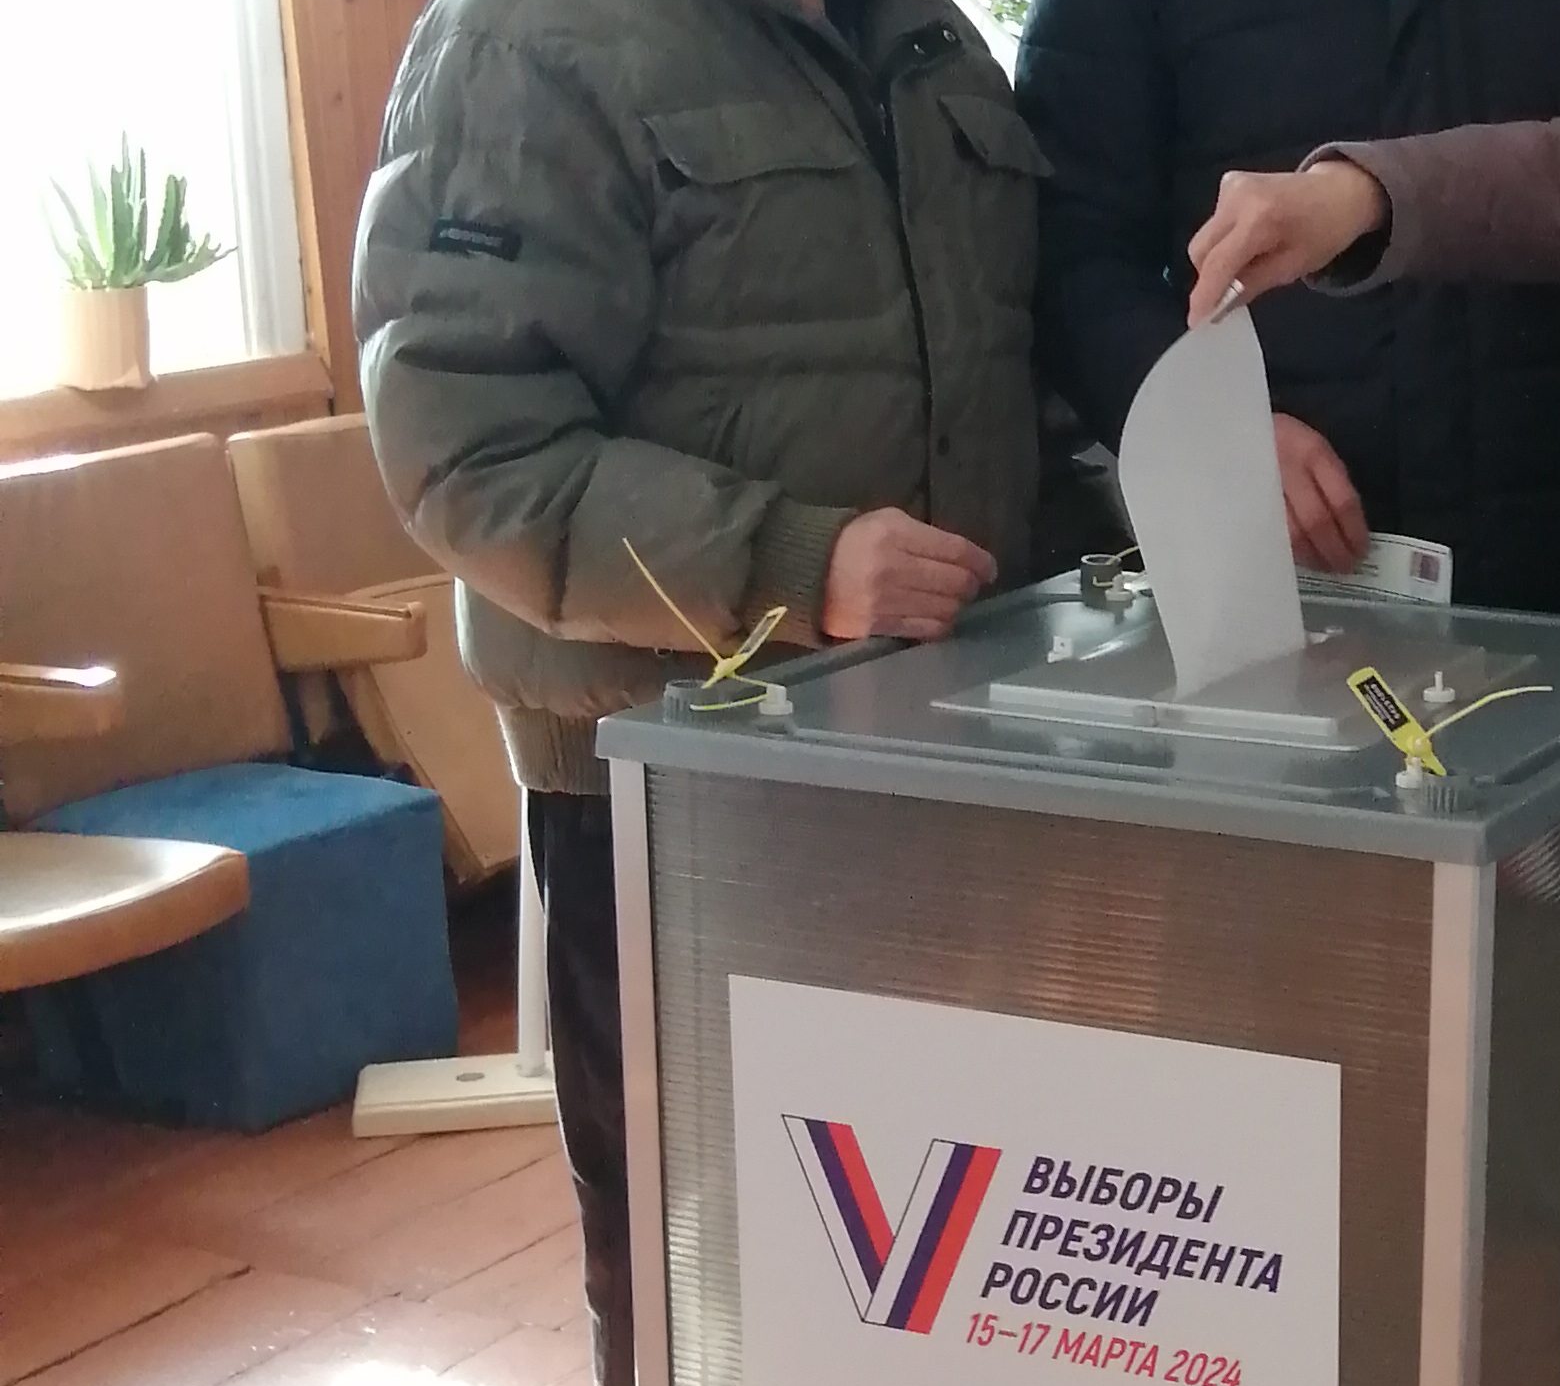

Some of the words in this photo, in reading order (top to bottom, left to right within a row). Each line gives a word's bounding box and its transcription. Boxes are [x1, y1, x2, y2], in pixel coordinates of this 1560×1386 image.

[1022, 1155, 1225, 1224] ВЫБОРЫ
[1000, 1209, 1284, 1293] ПРЕЗИДЕНТА
[979, 1262, 1159, 1327] РОССИИ
[1052, 1327, 1159, 1378] МАРТА
